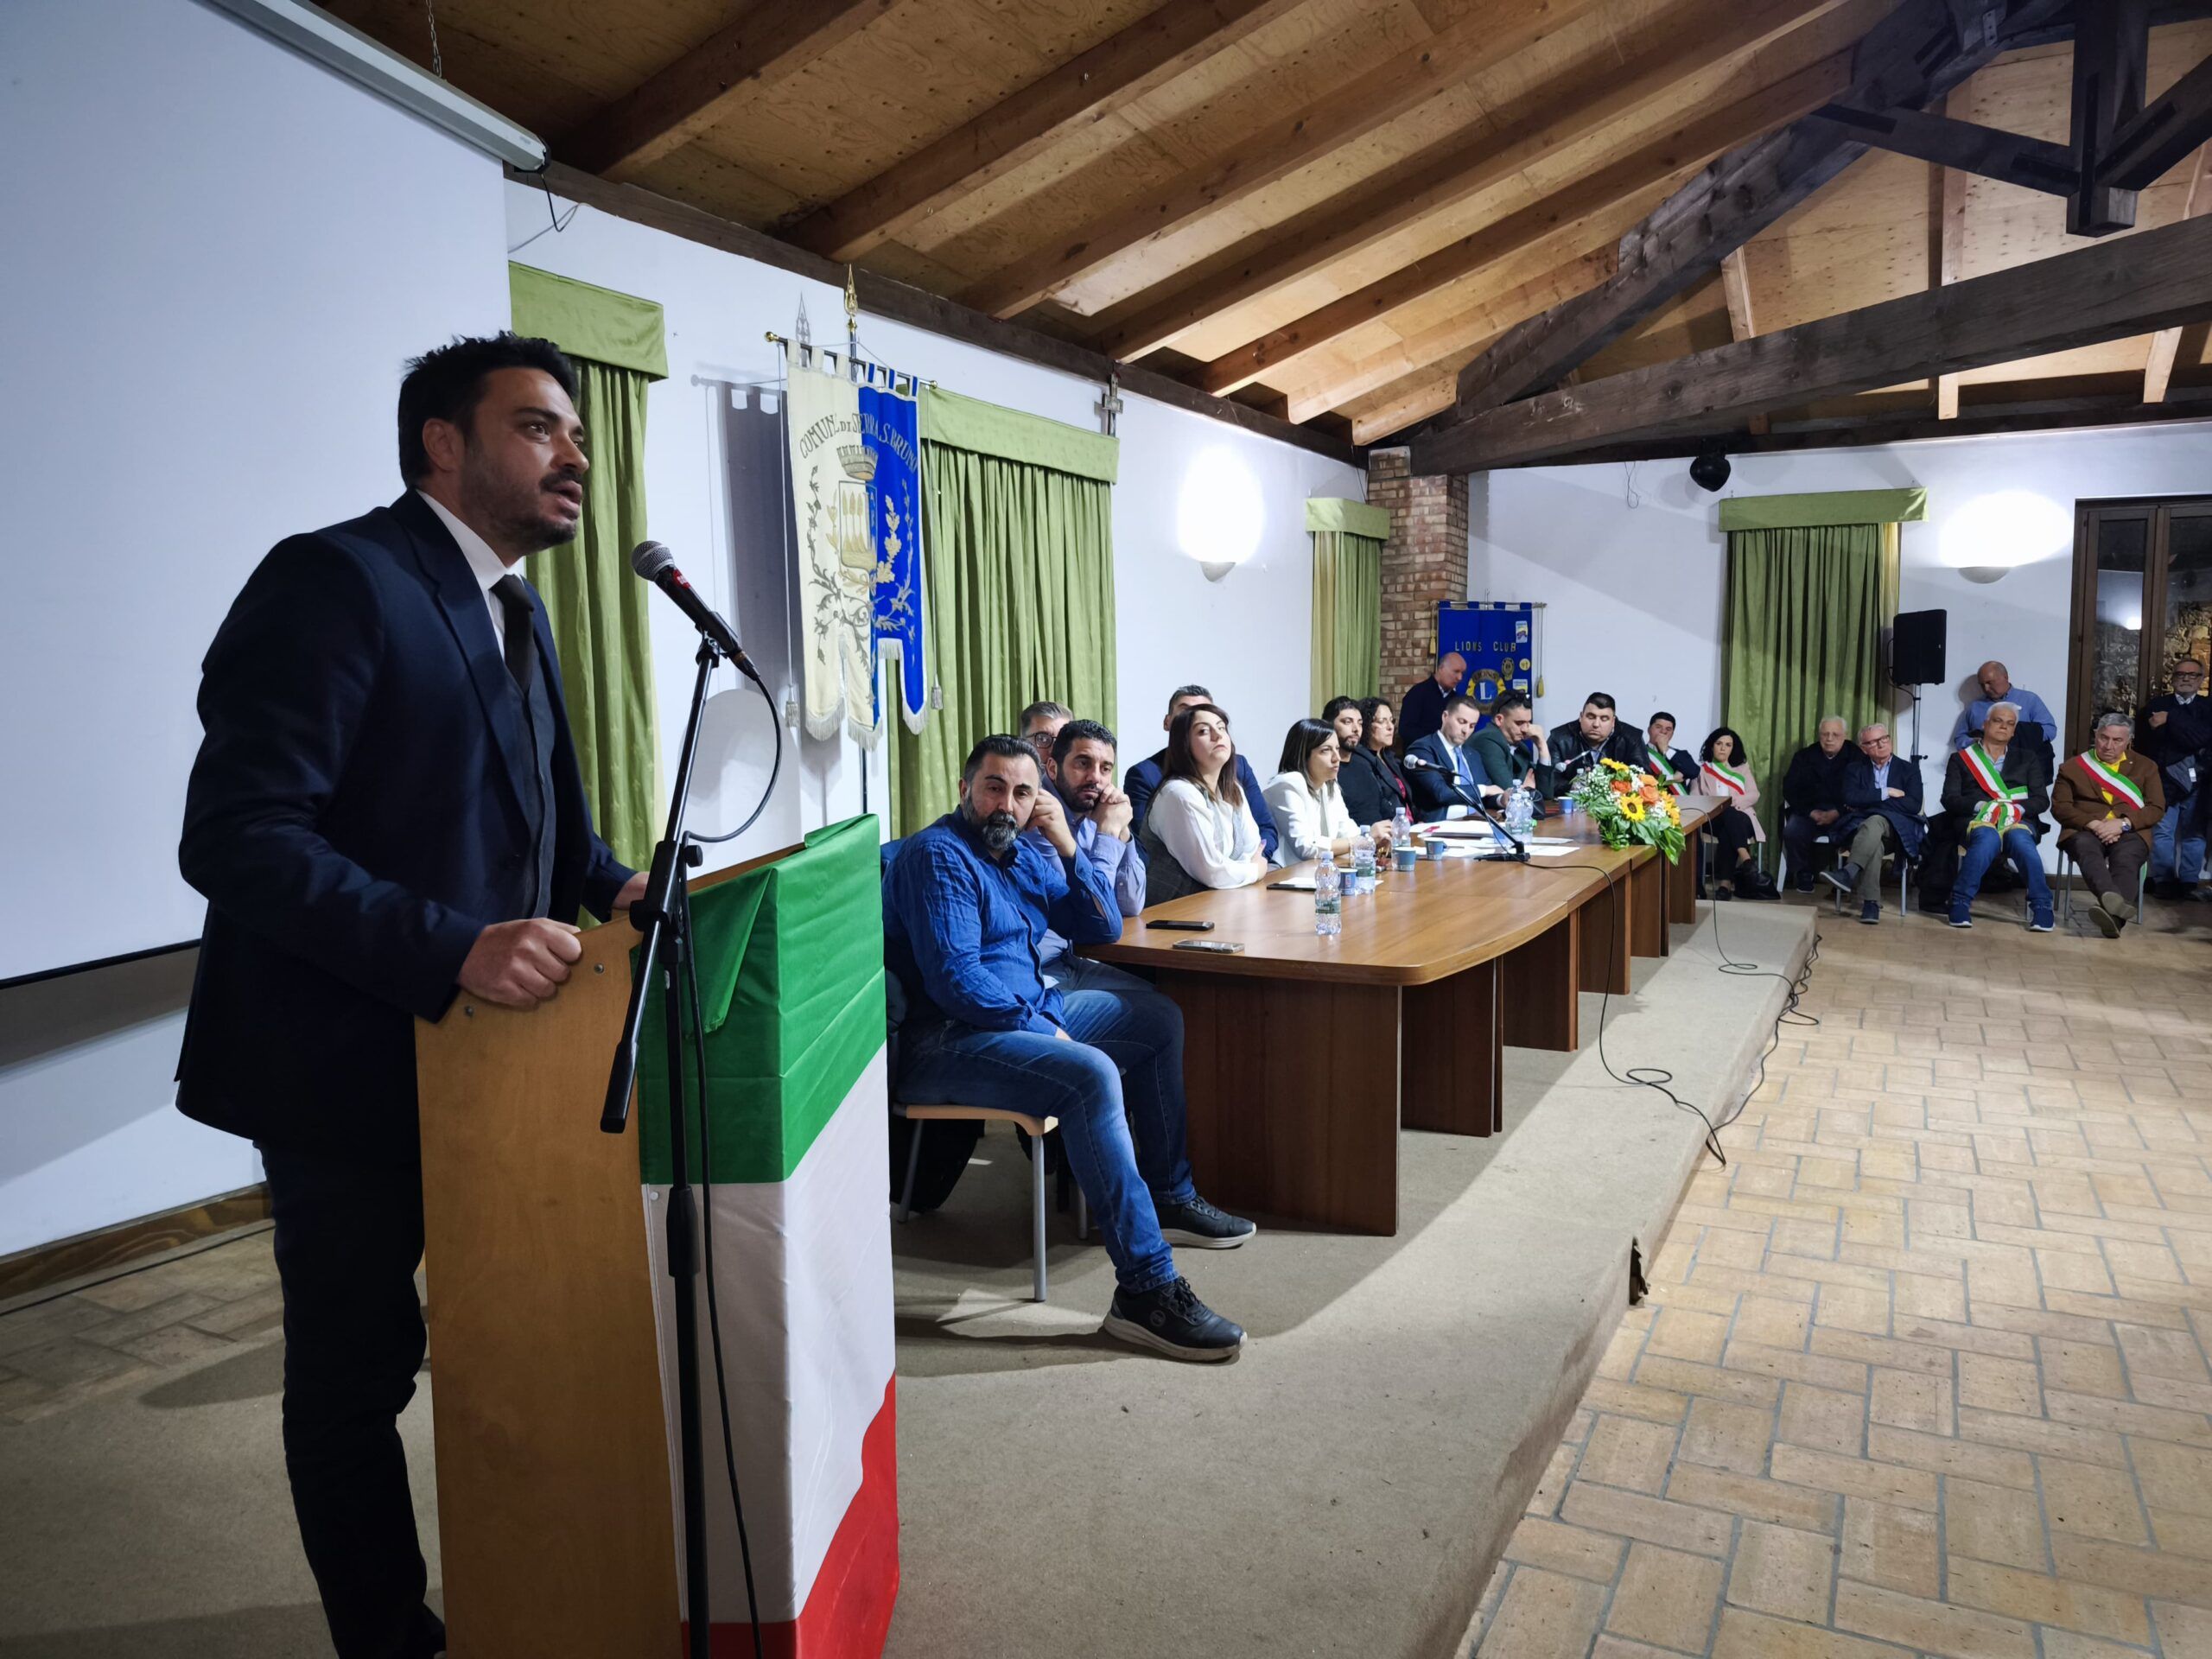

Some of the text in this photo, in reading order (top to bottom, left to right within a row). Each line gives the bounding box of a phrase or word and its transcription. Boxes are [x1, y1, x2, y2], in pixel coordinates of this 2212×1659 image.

[840, 420, 851, 432] DI
[1455, 641, 1516, 652] LIONS CLUB
[1479, 682, 1492, 699] L
